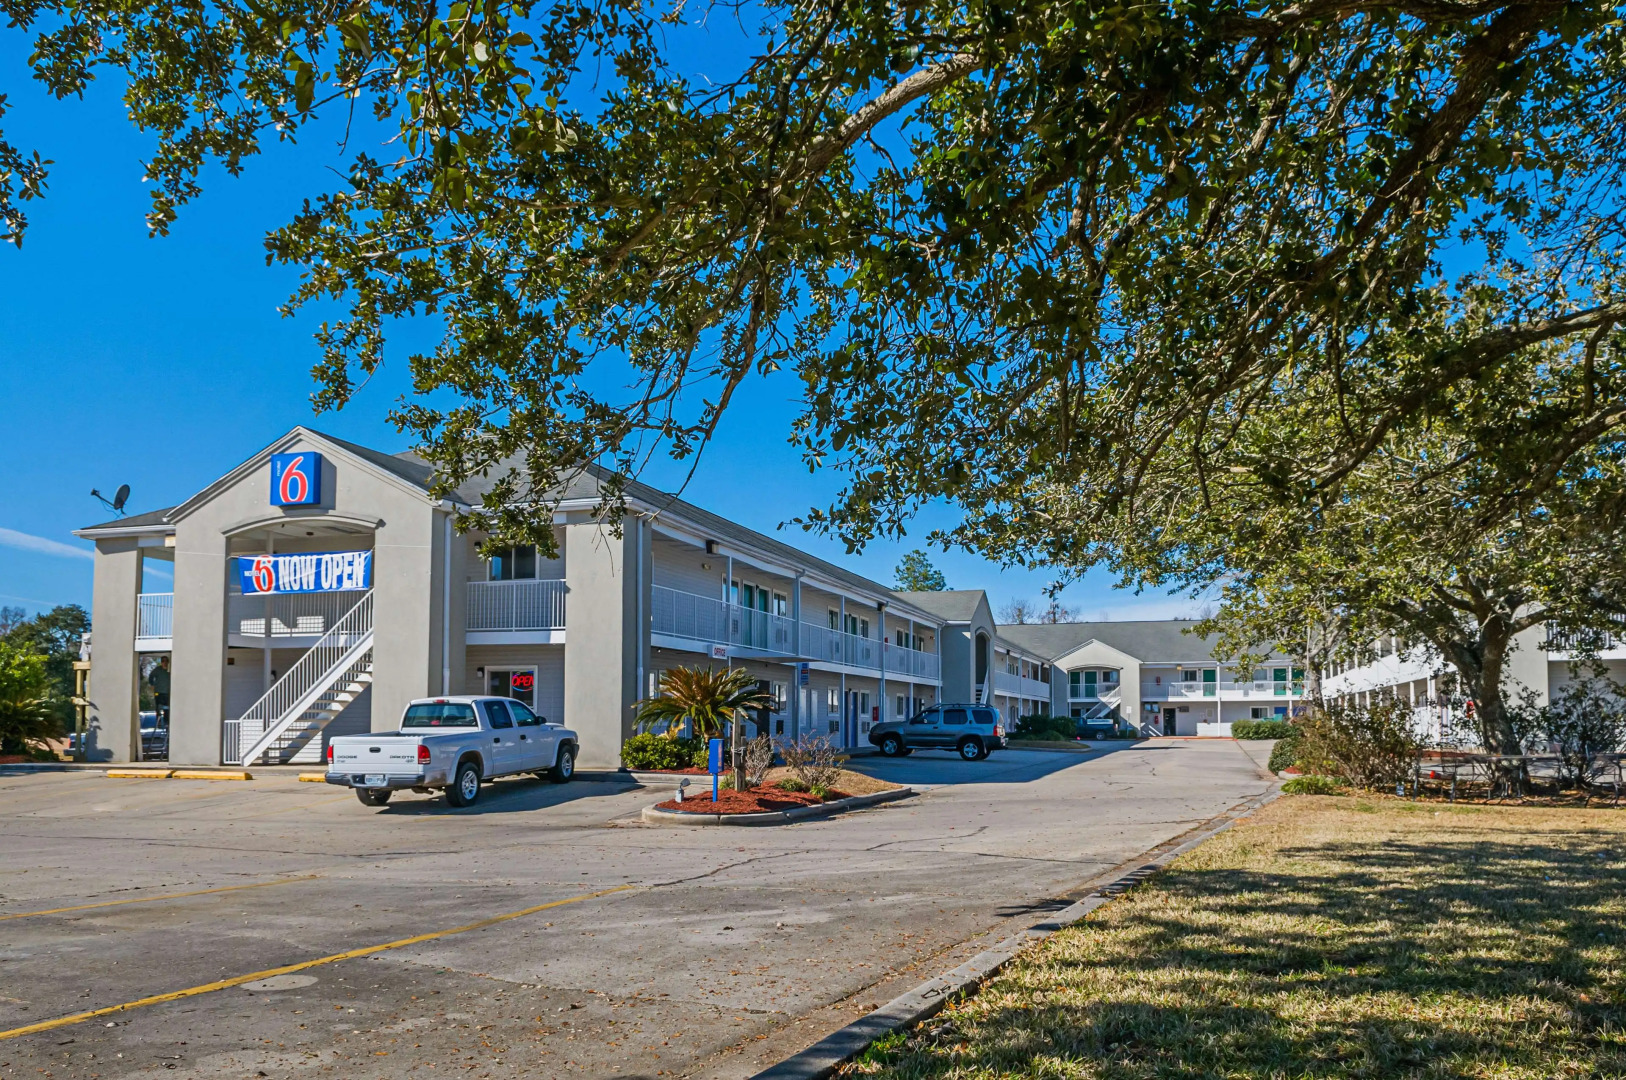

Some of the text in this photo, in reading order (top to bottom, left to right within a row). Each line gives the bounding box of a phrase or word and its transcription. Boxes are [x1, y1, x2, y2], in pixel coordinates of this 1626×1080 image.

[279, 455, 308, 503] 6
[252, 555, 275, 593] 6
[278, 555, 316, 591] NOW
[320, 552, 366, 590] OPEN
[512, 676, 534, 686] OPEN
